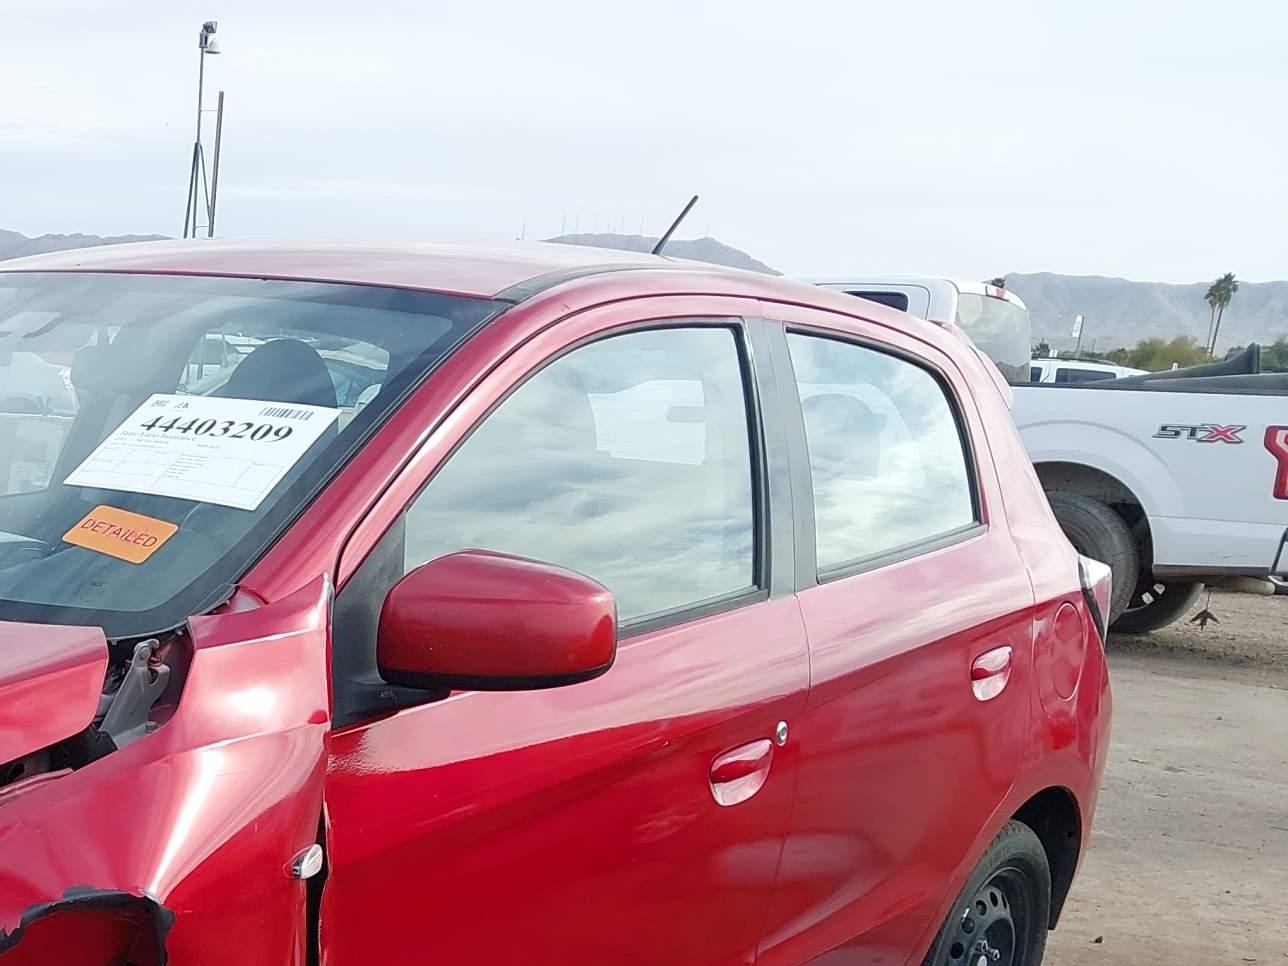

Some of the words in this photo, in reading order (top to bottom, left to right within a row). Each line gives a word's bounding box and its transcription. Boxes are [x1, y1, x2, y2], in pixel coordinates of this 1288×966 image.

[140, 416, 293, 443] 44403209
[1152, 423, 1248, 444] STX
[80, 518, 158, 548] DETAILED
